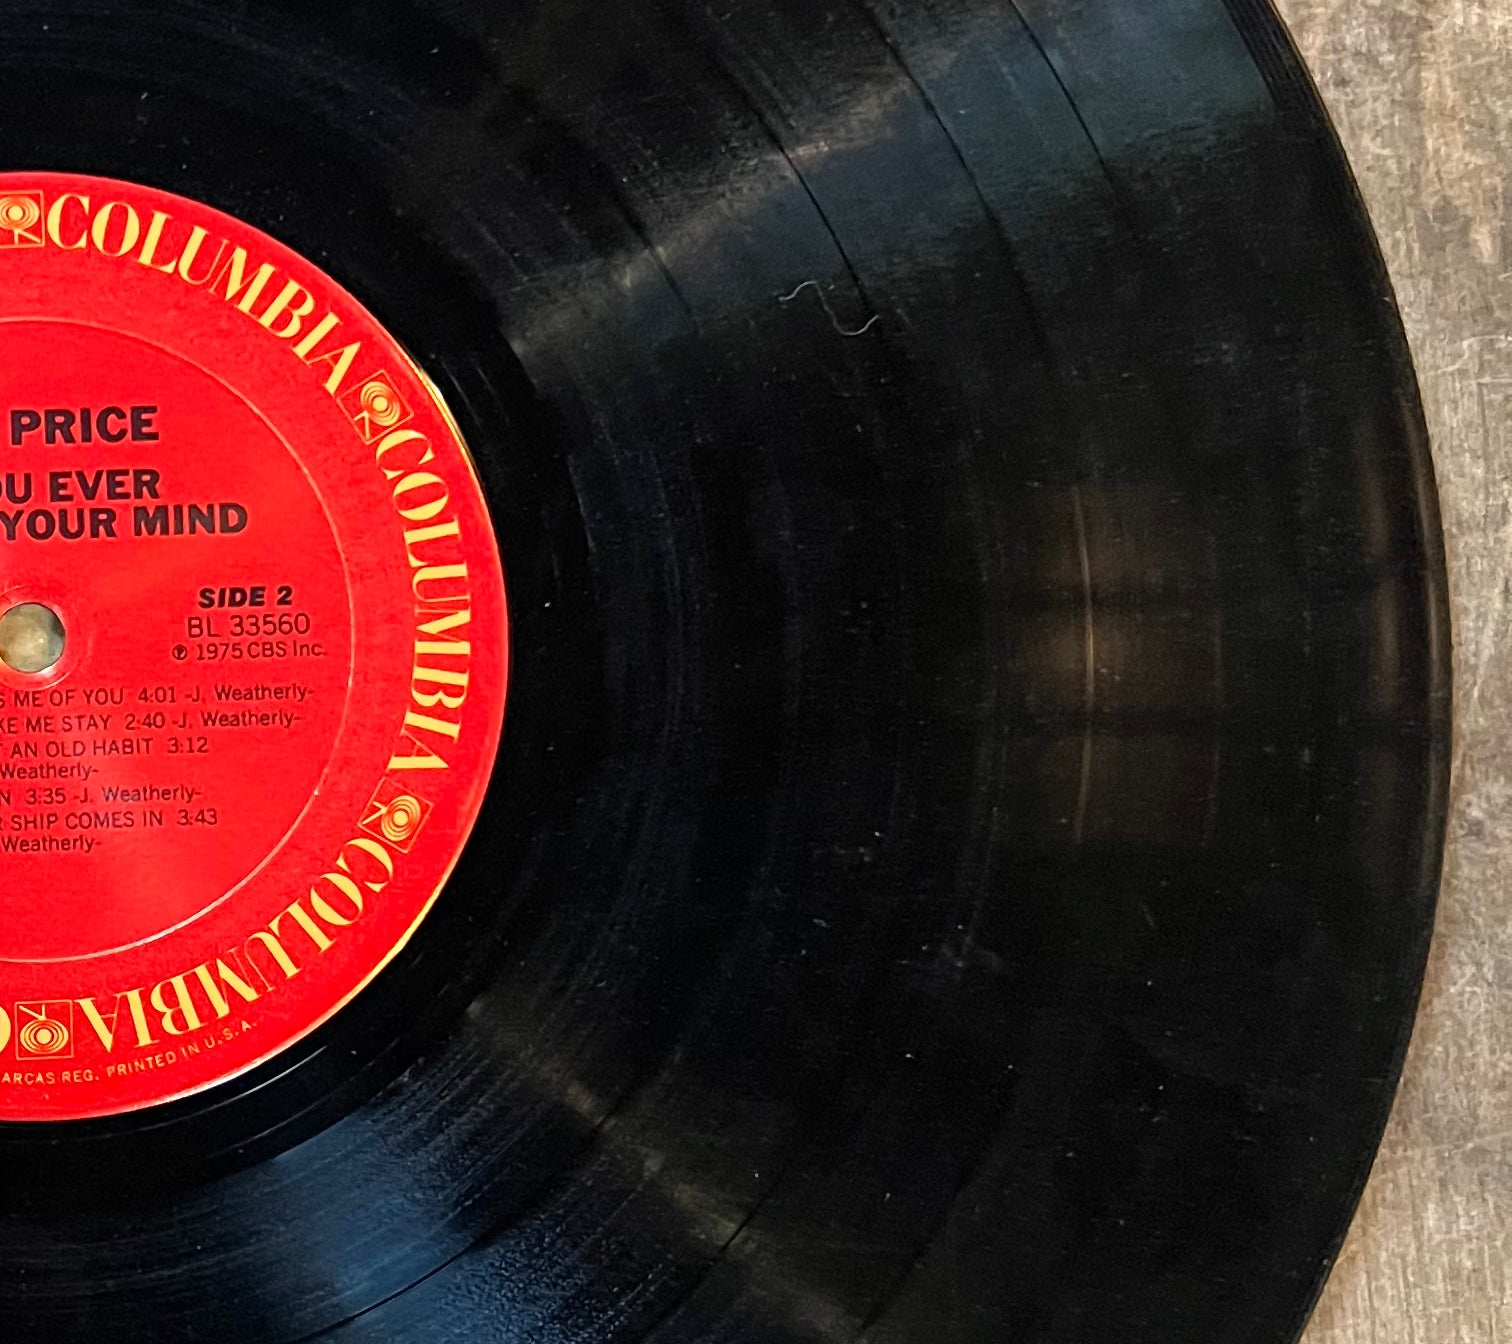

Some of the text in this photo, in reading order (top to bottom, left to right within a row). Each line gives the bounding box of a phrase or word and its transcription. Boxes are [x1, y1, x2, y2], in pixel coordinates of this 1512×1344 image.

[47, 194, 365, 396] COLUMBIA
[11, 405, 159, 445] PRICE
[49, 468, 160, 503] EVER
[133, 502, 248, 537] MIND
[198, 585, 293, 609] SIDE 2
[375, 430, 471, 773] COLUMBIA
[188, 612, 310, 638] BL 33560
[196, 642, 243, 661] 1975
[247, 641, 287, 659] CBS
[13, 690, 42, 707] ME
[49, 689, 75, 706] OF
[83, 688, 124, 705] YOU
[138, 686, 176, 704] 4:01
[214, 683, 315, 702] Weatherly-
[26, 715, 54, 733] ME
[62, 714, 112, 732] STAY
[125, 711, 166, 730] 2:40
[200, 709, 302, 728] Weatherly-
[10, 741, 38, 758] AN
[45, 740, 86, 758] OLD
[93, 737, 154, 756] HABIT
[167, 736, 209, 754] 3:12
[25, 788, 67, 805] 3:35
[102, 784, 202, 803] Weatherly-
[11, 812, 59, 832] SHIP
[65, 810, 135, 830] COMES
[142, 809, 163, 828] IN
[177, 807, 218, 826] 3:43
[0, 834, 102, 854] Weatherly-
[74, 834, 397, 1053] COLUMBIA
[61, 1069, 100, 1084] REG.
[106, 1051, 177, 1078] PRINTED
[181, 1045, 201, 1058] IN
